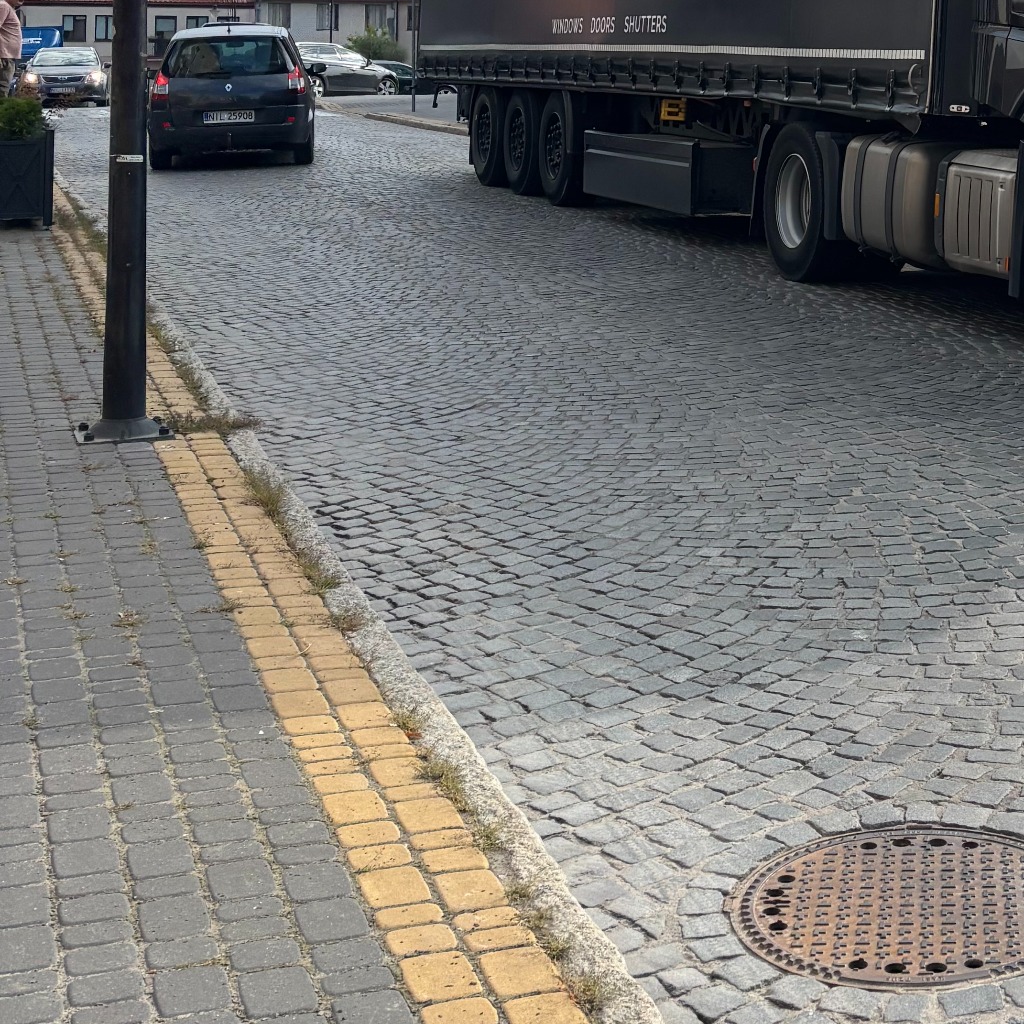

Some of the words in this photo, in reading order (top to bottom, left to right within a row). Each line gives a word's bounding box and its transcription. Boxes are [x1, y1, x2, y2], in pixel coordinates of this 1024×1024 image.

[552, 17, 583, 34] WINDOWS
[590, 16, 616, 34] DOORS
[624, 15, 667, 33] SHUTTERS
